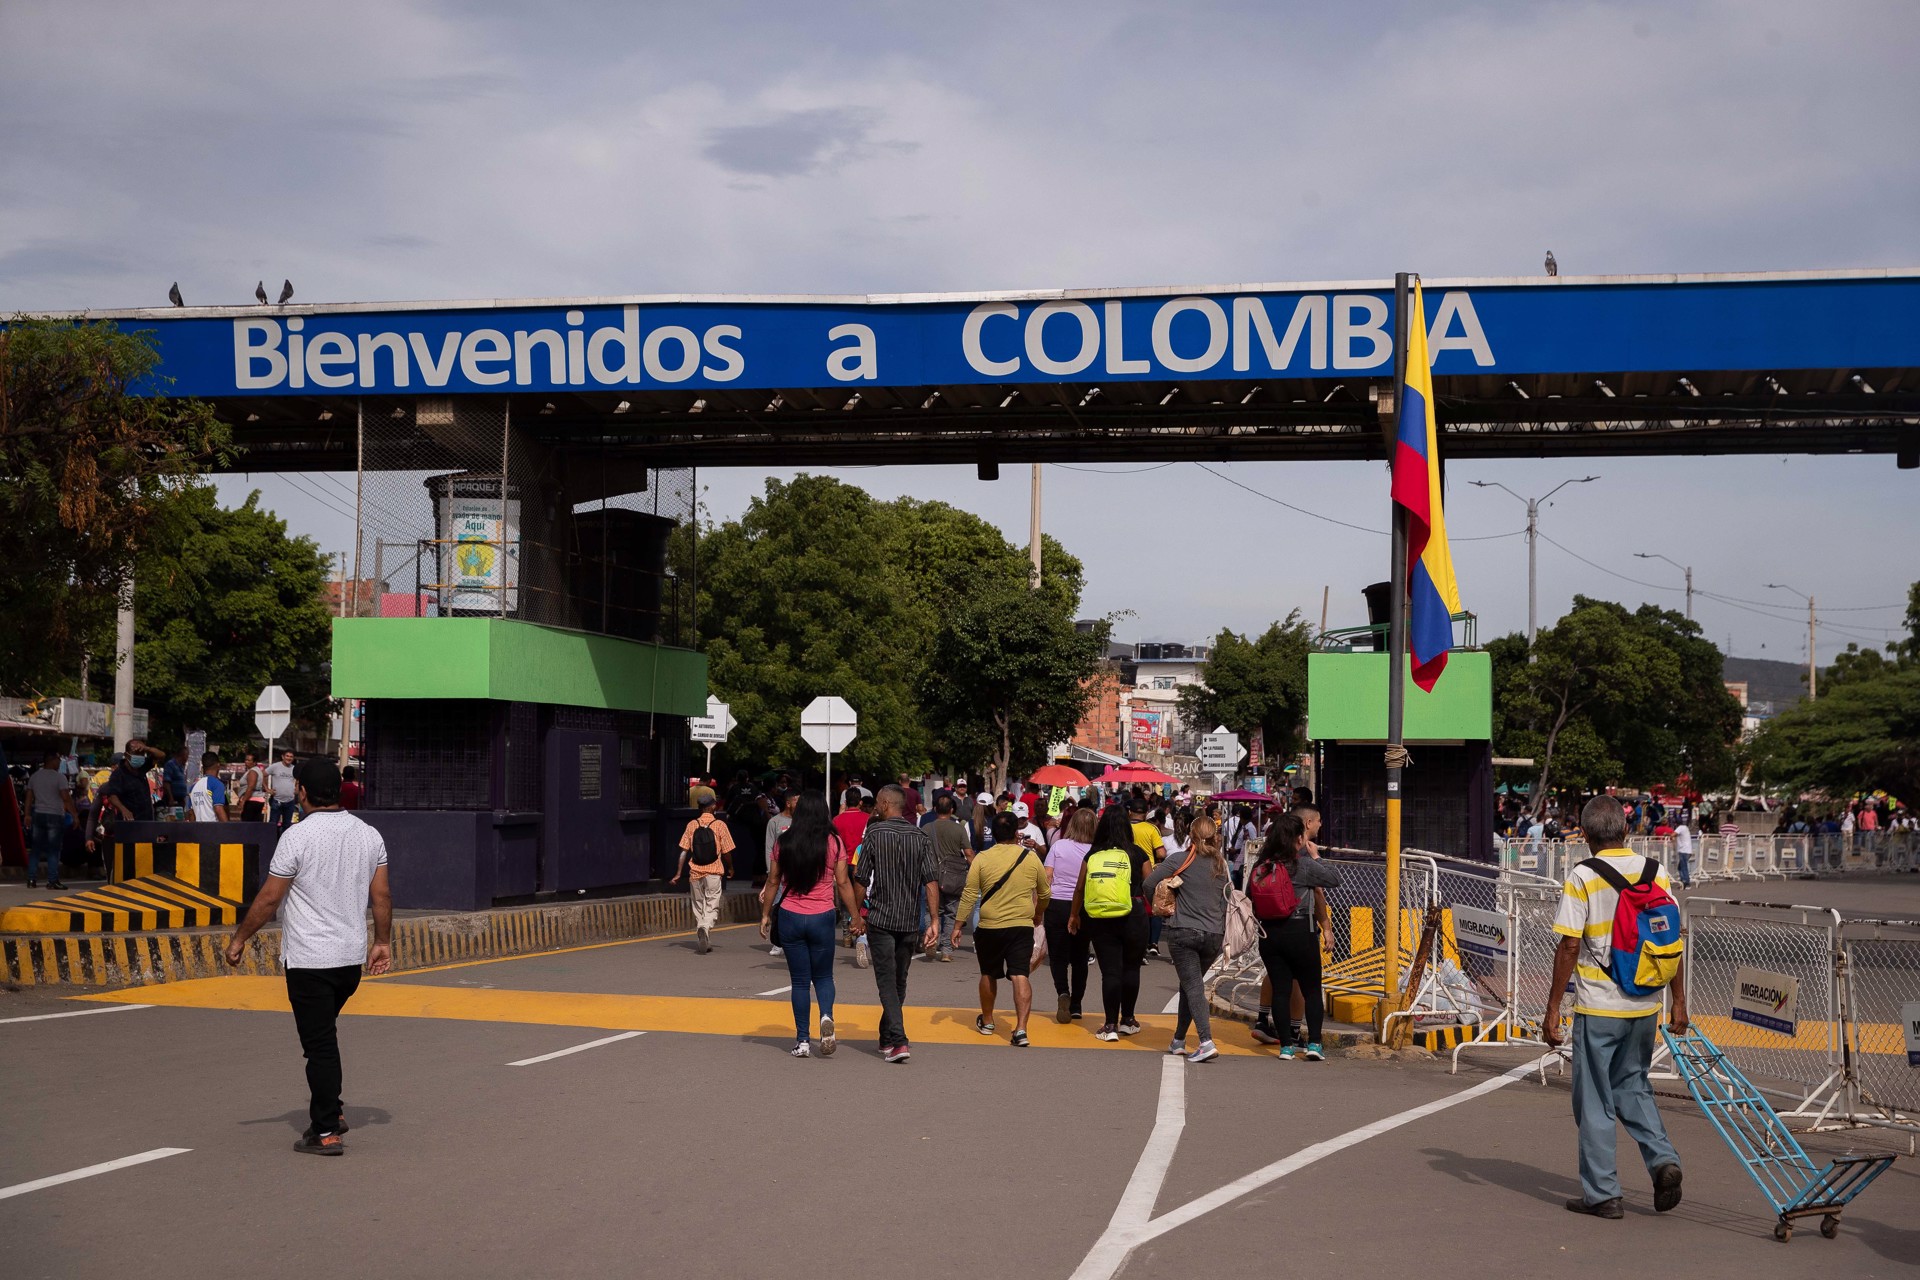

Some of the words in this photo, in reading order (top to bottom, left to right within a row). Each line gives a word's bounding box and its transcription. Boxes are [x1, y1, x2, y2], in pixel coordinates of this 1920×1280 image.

[234, 305, 745, 390] Bienvenidos
[826, 323, 878, 382] a
[962, 290, 1496, 376] COLOMBA
[464, 520, 485, 532] Aquí
[1458, 918, 1503, 937] MIGRACIÓN
[1740, 982, 1782, 1003] MIGRACIÓN
